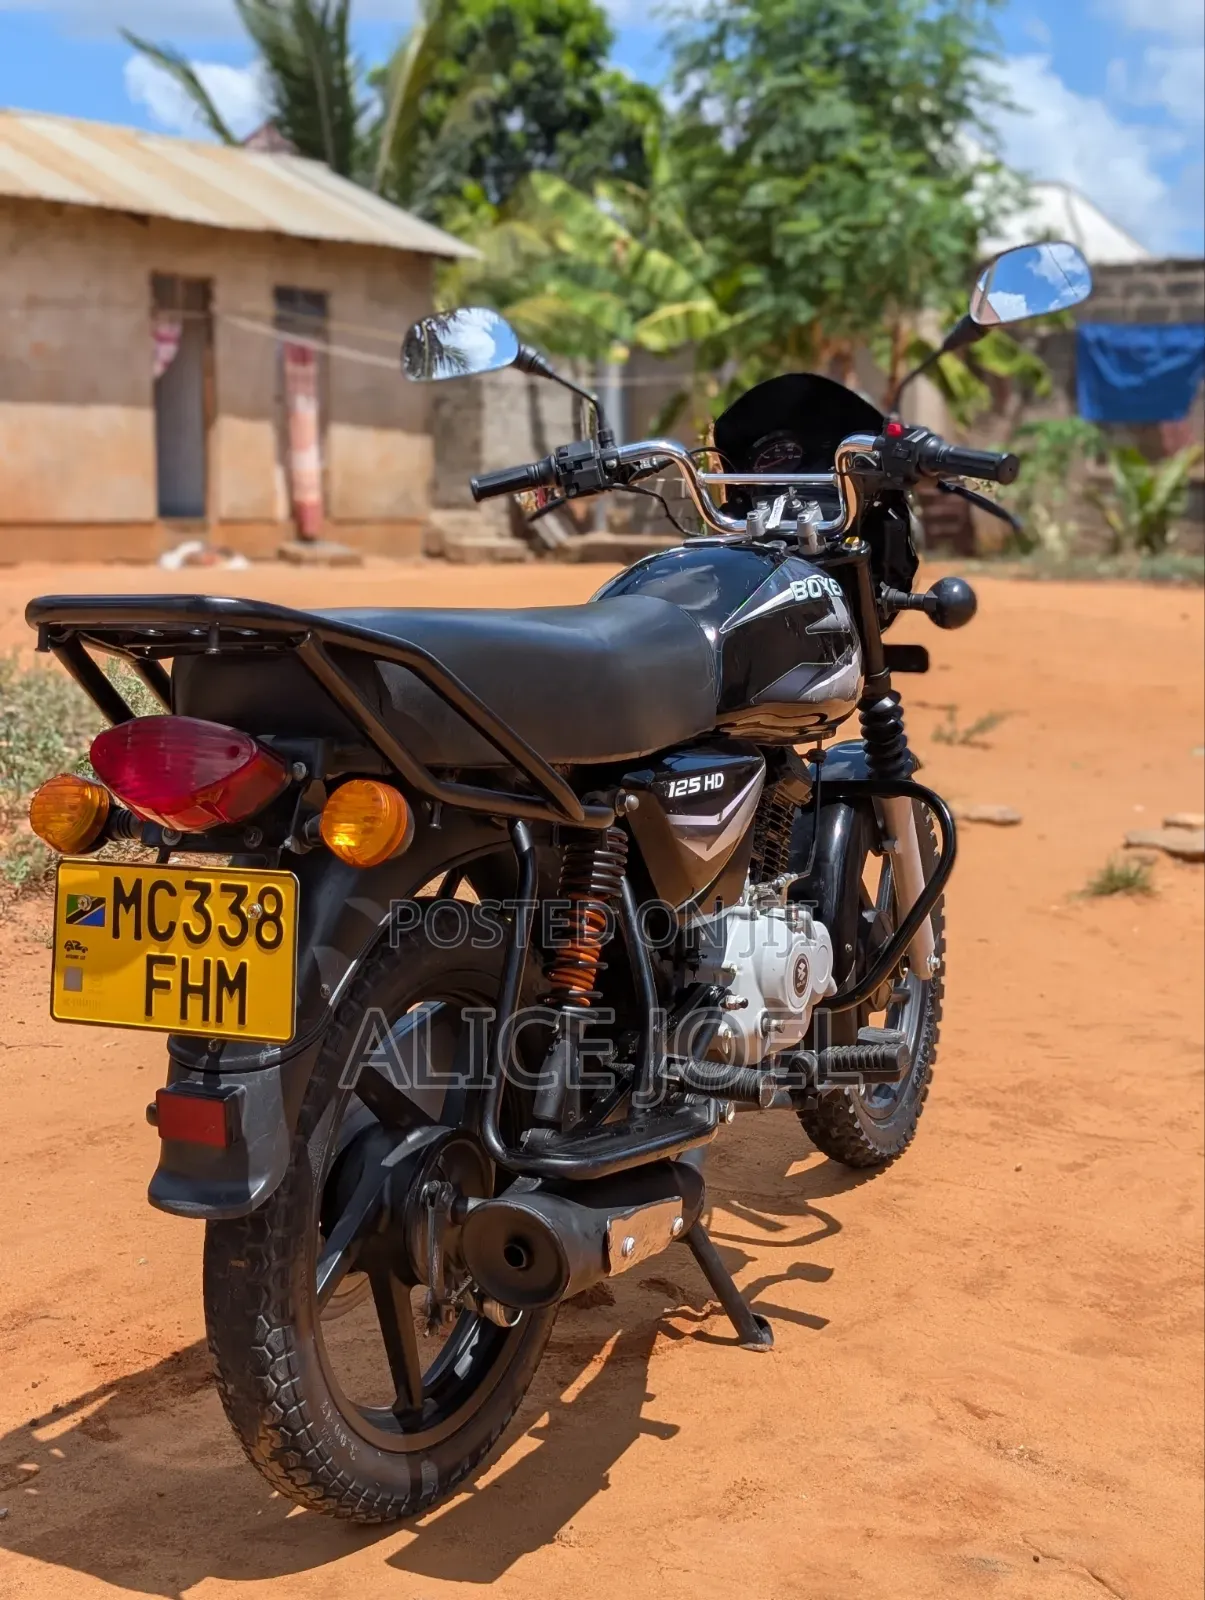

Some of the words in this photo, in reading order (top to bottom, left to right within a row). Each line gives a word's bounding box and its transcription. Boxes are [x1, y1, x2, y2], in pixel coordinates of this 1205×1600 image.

[668, 777, 701, 798] 125
[704, 773, 724, 791] HD
[112, 876, 285, 950] MC338
[144, 953, 248, 1026] FHM
